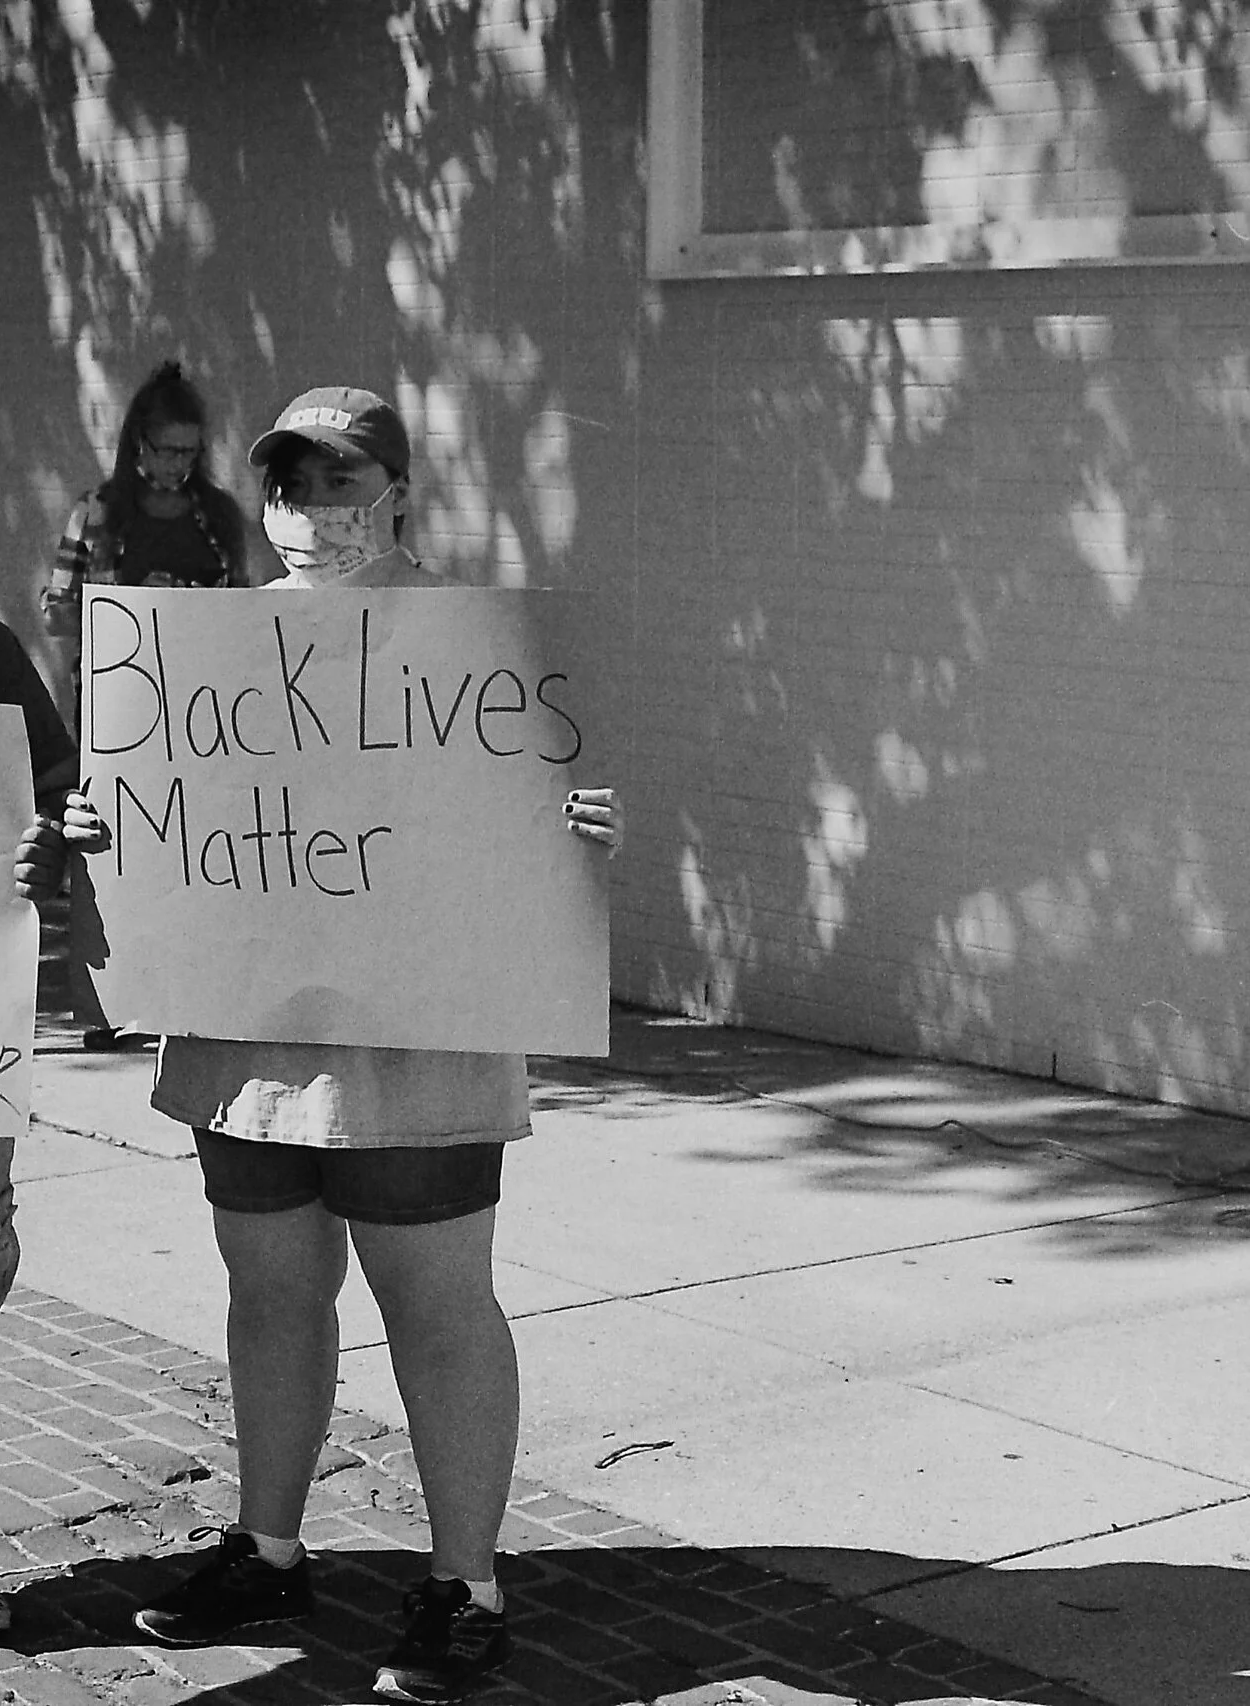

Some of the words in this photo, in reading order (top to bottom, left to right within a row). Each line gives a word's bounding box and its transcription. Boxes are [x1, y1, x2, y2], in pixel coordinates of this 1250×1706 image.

[90, 596, 330, 762] Black
[359, 608, 582, 764] Lives
[115, 776, 392, 897] Matter
